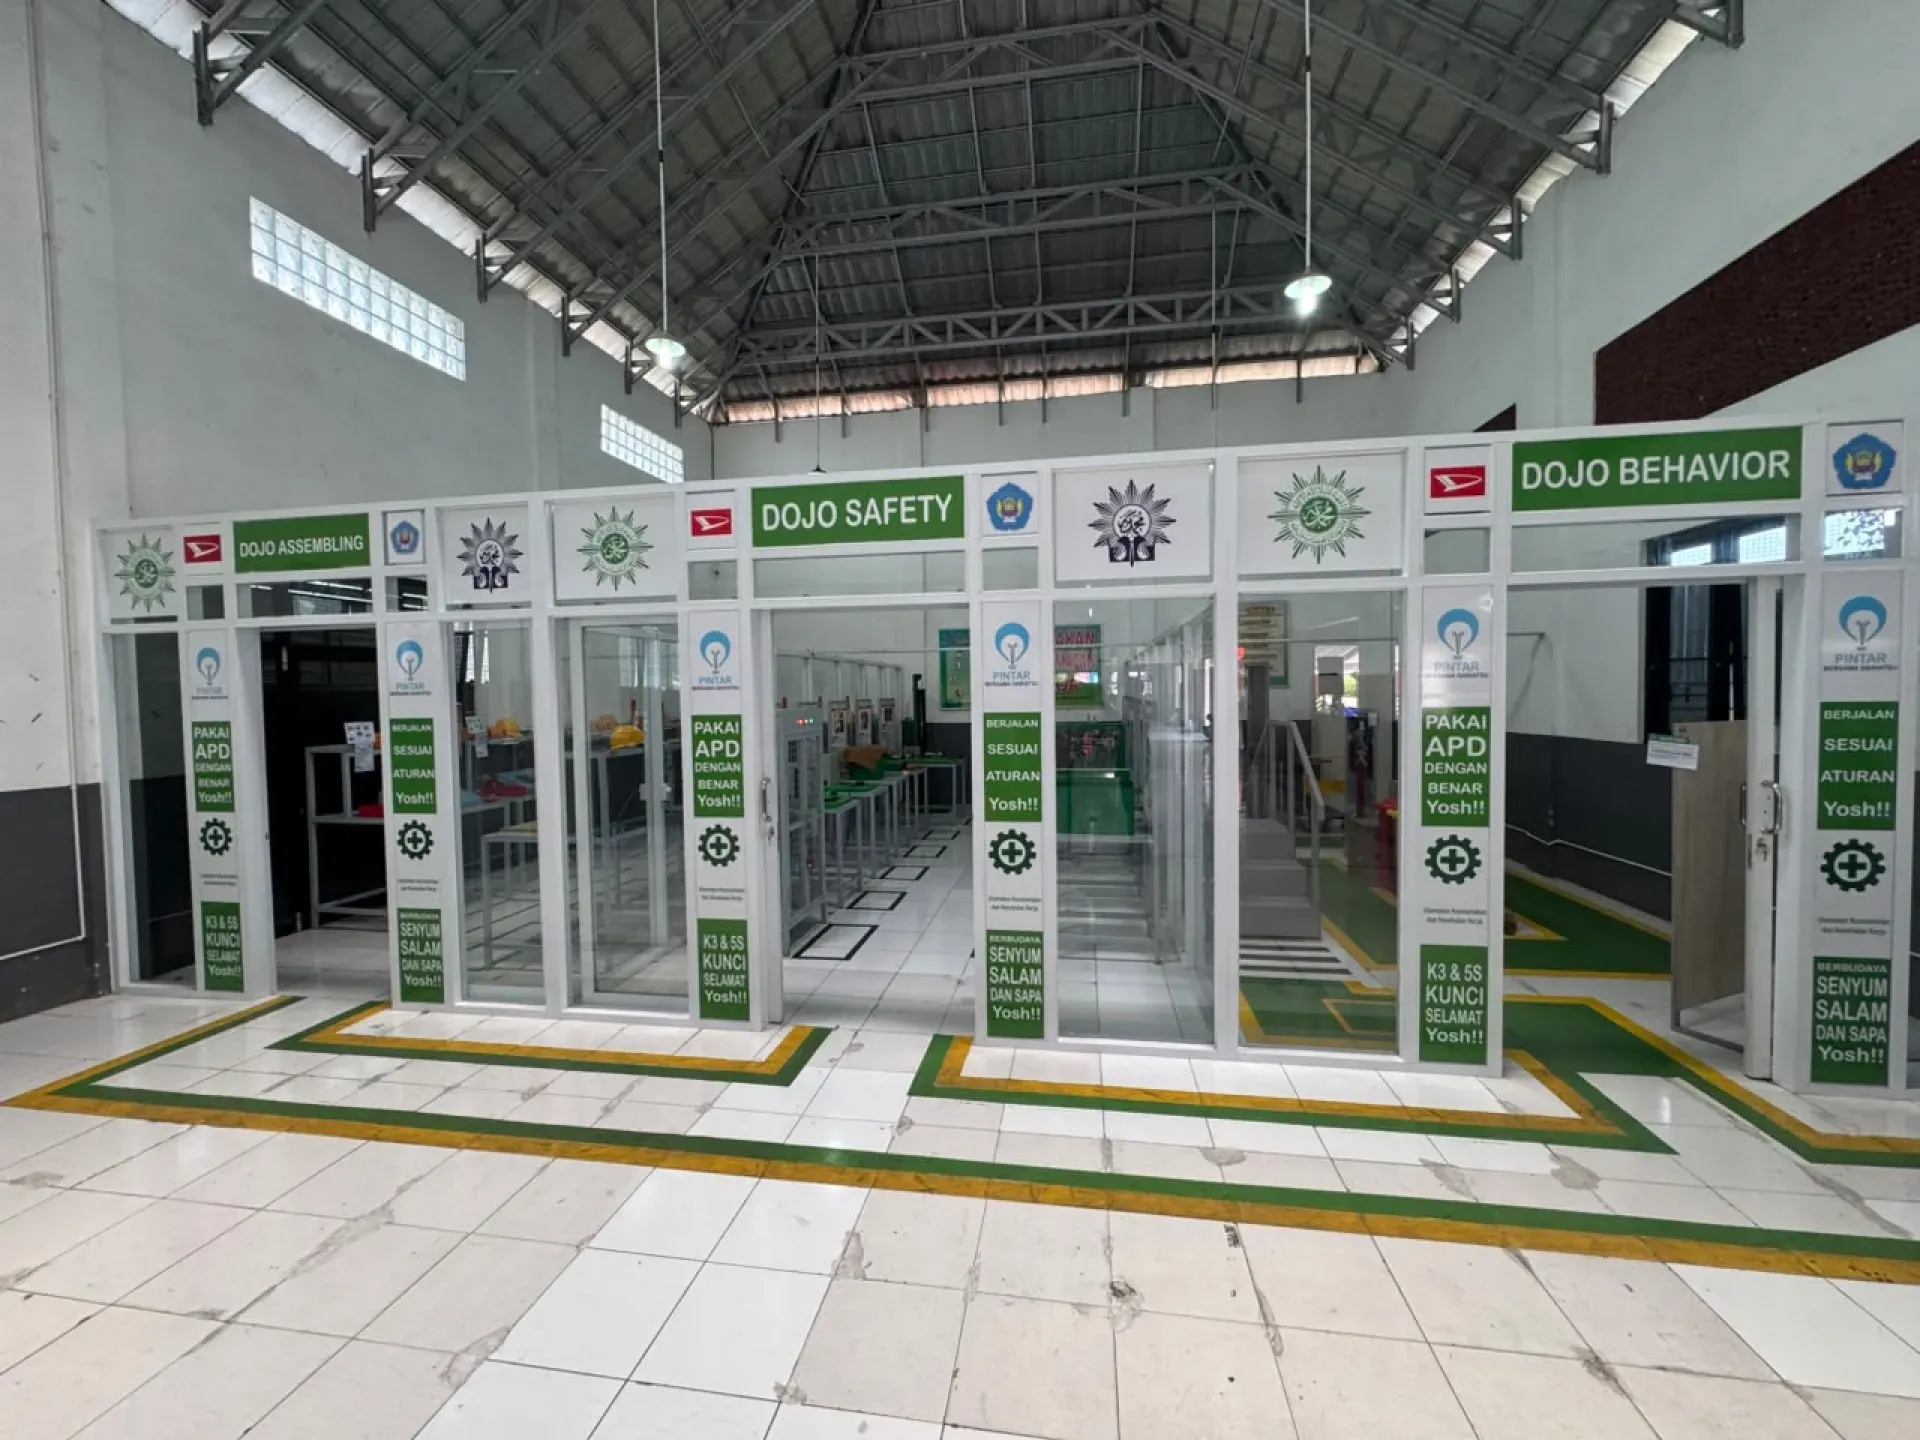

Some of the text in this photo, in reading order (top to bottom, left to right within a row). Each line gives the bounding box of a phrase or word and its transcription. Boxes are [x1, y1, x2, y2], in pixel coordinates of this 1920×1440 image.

[1521, 450, 1790, 490] DOJO BEHAVIOR
[761, 493, 953, 532] DOJO SAFETY
[239, 534, 364, 558] DOJO ASSEMBLING
[1835, 652, 1887, 664] PINTAR
[1434, 662, 1480, 672] PINTAR
[698, 676, 732, 684] PINTAR
[992, 671, 1030, 680] PINTAR
[1824, 710, 1894, 720] BERJALAN
[694, 721, 739, 734] PAKAI
[986, 720, 1038, 728] BERJALAN
[1426, 715, 1488, 730] PAKAI
[194, 726, 229, 739] PAKAI
[194, 744, 230, 759] APD
[393, 745, 432, 756] SESUAI
[695, 740, 740, 758] APD
[987, 744, 1038, 755] SESUAI
[1425, 736, 1487, 757] APD
[1824, 738, 1892, 751] SESUAI
[196, 763, 232, 772] DENGAN
[392, 768, 435, 779] ATURAN
[695, 762, 741, 773] DENGAN
[1424, 762, 1488, 774] DENGAN
[986, 771, 1040, 782] ATURAN
[1820, 770, 1895, 782] ATURAN
[697, 780, 739, 790] BENAR
[1428, 782, 1483, 794] BENAR
[198, 792, 232, 804] Yosh!!
[396, 792, 434, 805] Yosh!!
[697, 794, 741, 808] Yosh!!
[989, 798, 1038, 811] Yosh!!
[1427, 800, 1485, 815] Yosh!!
[1824, 801, 1890, 817] Yosh!!
[400, 922, 440, 937] SENYUM
[206, 933, 240, 948] KUNCI
[703, 934, 744, 950] K3 & 5S
[400, 940, 441, 956] SALAM
[989, 946, 1041, 964] SENYUM
[401, 960, 442, 972] DAN SAPA
[703, 953, 746, 970] KUNCI
[1817, 962, 1888, 973] BERBUDAYA
[208, 965, 241, 977] Yosh!!
[989, 966, 1042, 985] SALAM
[1427, 963, 1483, 982] K3 & 5S
[404, 974, 442, 988] Yosh!!
[703, 974, 746, 987] SELAMAT
[1816, 976, 1888, 997] SENYUM
[704, 990, 747, 1004] Yosh!!
[990, 989, 1042, 1002] DAN SAPA
[1426, 986, 1484, 1006] KUNCI
[992, 1006, 1040, 1020] Yosh!!
[1426, 1008, 1484, 1025] SELAMAT
[1816, 1000, 1887, 1022] SALAM
[1426, 1028, 1484, 1044] Yosh!!
[1816, 1026, 1887, 1043] DAN SAPA
[1818, 1047, 1884, 1064] Yosh!!
